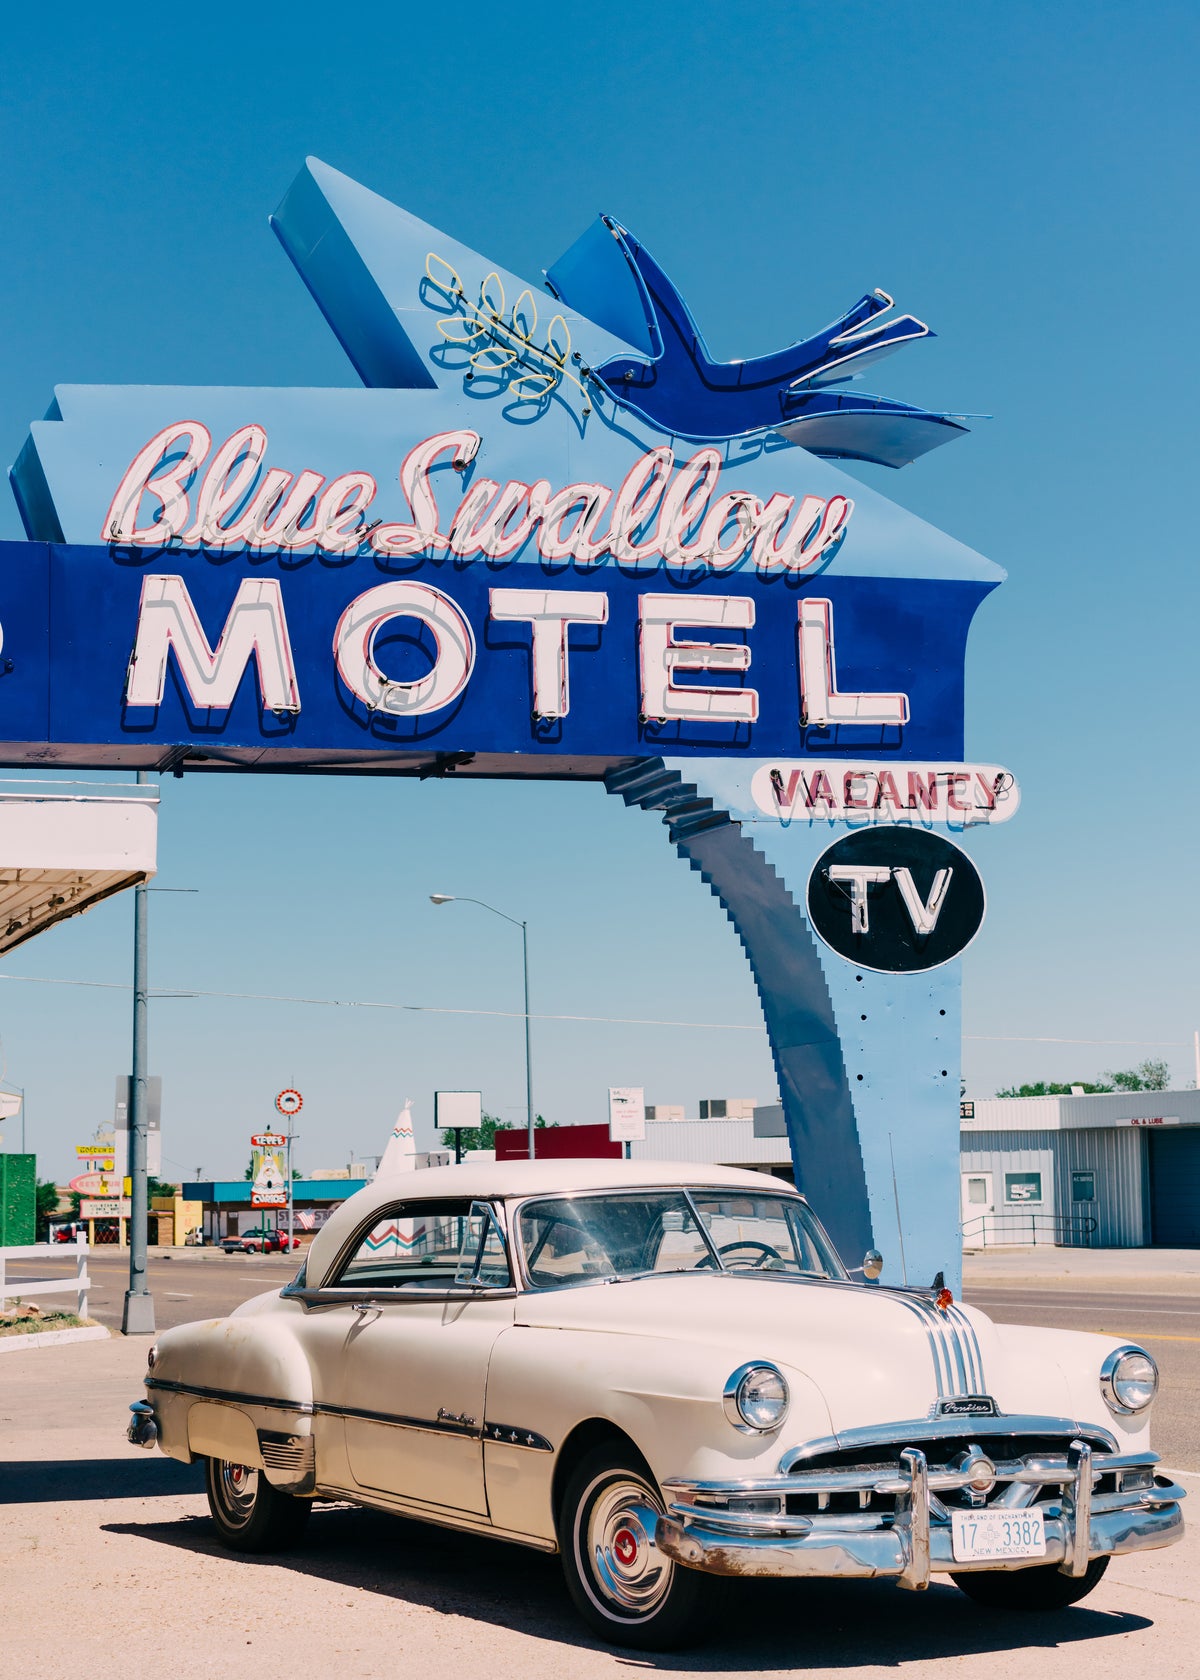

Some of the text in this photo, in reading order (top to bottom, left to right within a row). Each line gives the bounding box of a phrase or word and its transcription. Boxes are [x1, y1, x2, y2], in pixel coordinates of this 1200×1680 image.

[101, 419, 855, 571] Blue Swallow
[125, 573, 911, 727] MOTEL
[770, 768, 1012, 812] VACANCY
[826, 864, 954, 936] TV
[253, 1135, 284, 1145] TEPEE
[252, 1193, 286, 1204] CURIOS
[944, 1401, 989, 1413] Pontiac
[960, 1520, 1042, 1550] 17 3382
[996, 1546, 1027, 1554] MEXICO
